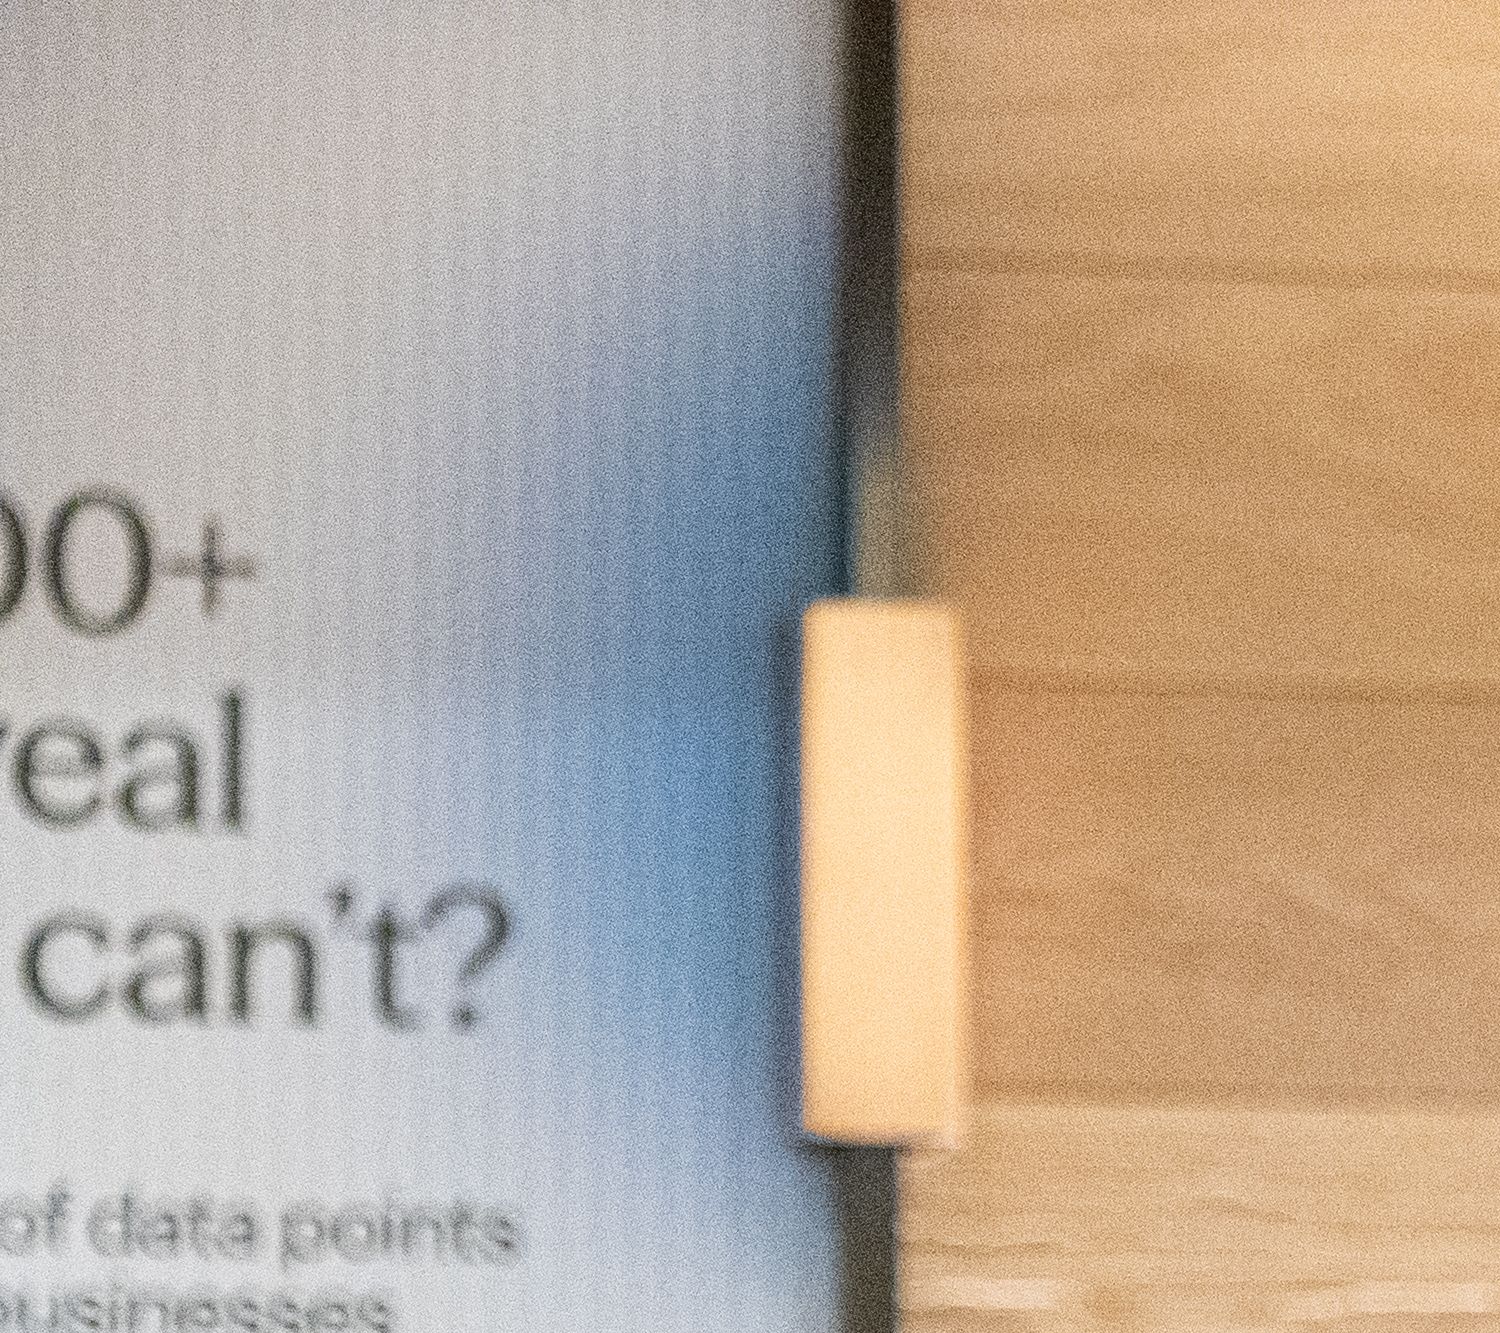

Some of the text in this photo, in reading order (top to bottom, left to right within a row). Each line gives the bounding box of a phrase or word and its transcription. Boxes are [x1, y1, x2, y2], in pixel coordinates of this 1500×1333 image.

[0, 686, 248, 830] eal
[19, 882, 520, 1032] can't?
[0, 1182, 526, 1272] of data points
